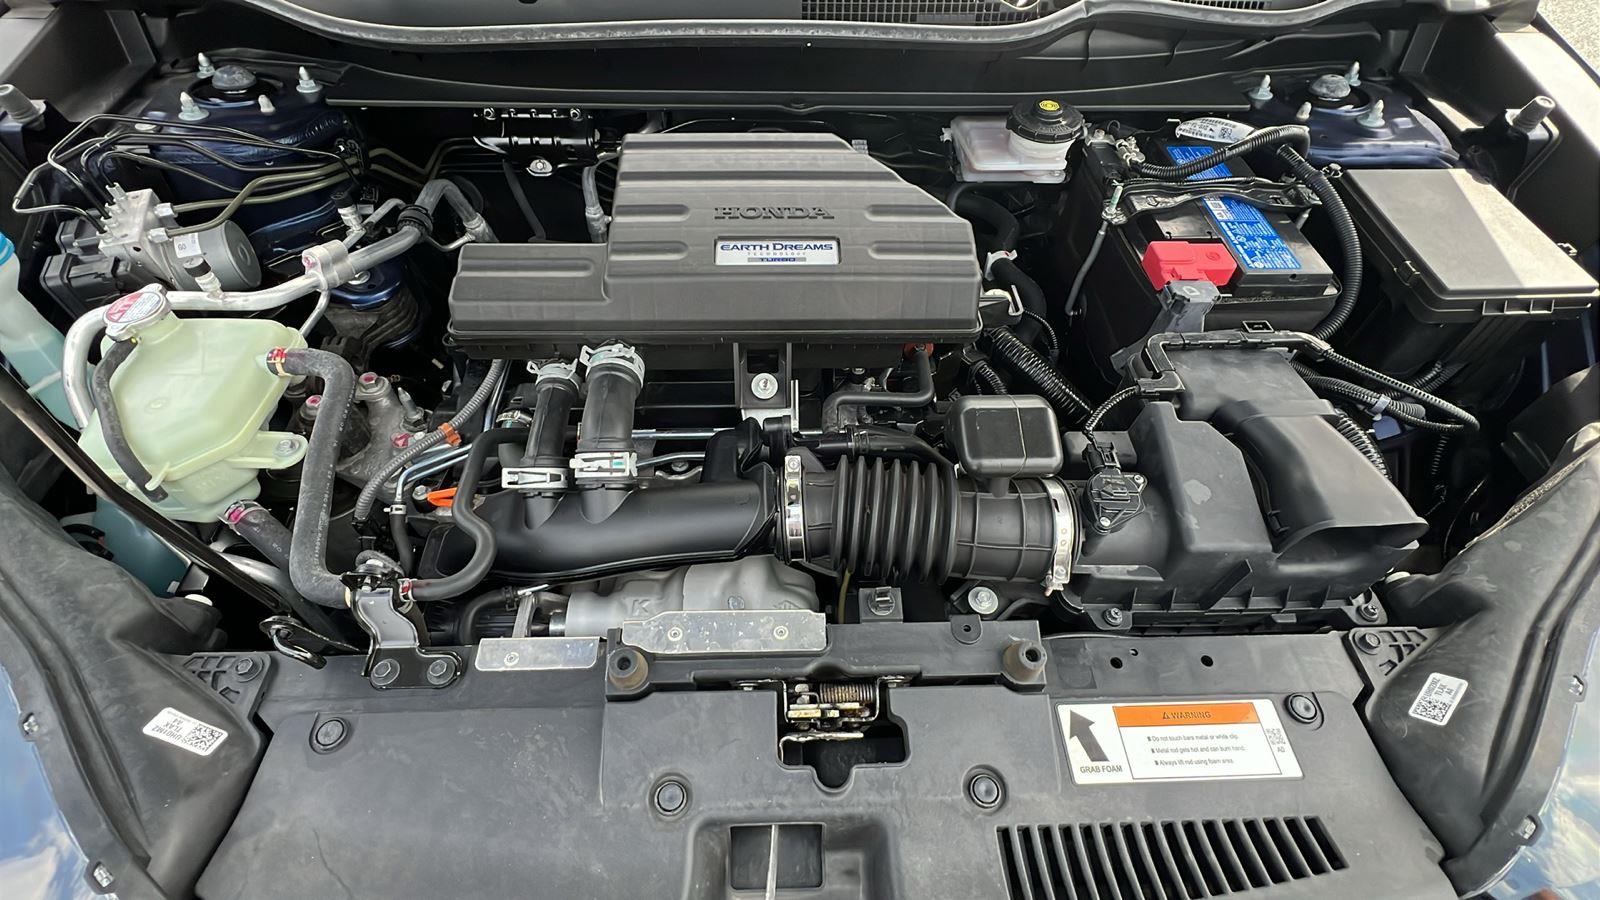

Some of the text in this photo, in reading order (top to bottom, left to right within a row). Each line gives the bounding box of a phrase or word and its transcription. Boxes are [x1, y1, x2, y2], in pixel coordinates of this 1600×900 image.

[714, 207, 835, 220] HONDA
[772, 242, 833, 251] DREAMS
[1170, 711, 1212, 719] WARNING
[1159, 759, 1177, 767] Always
[1080, 764, 1122, 773] GRAB FOAM
